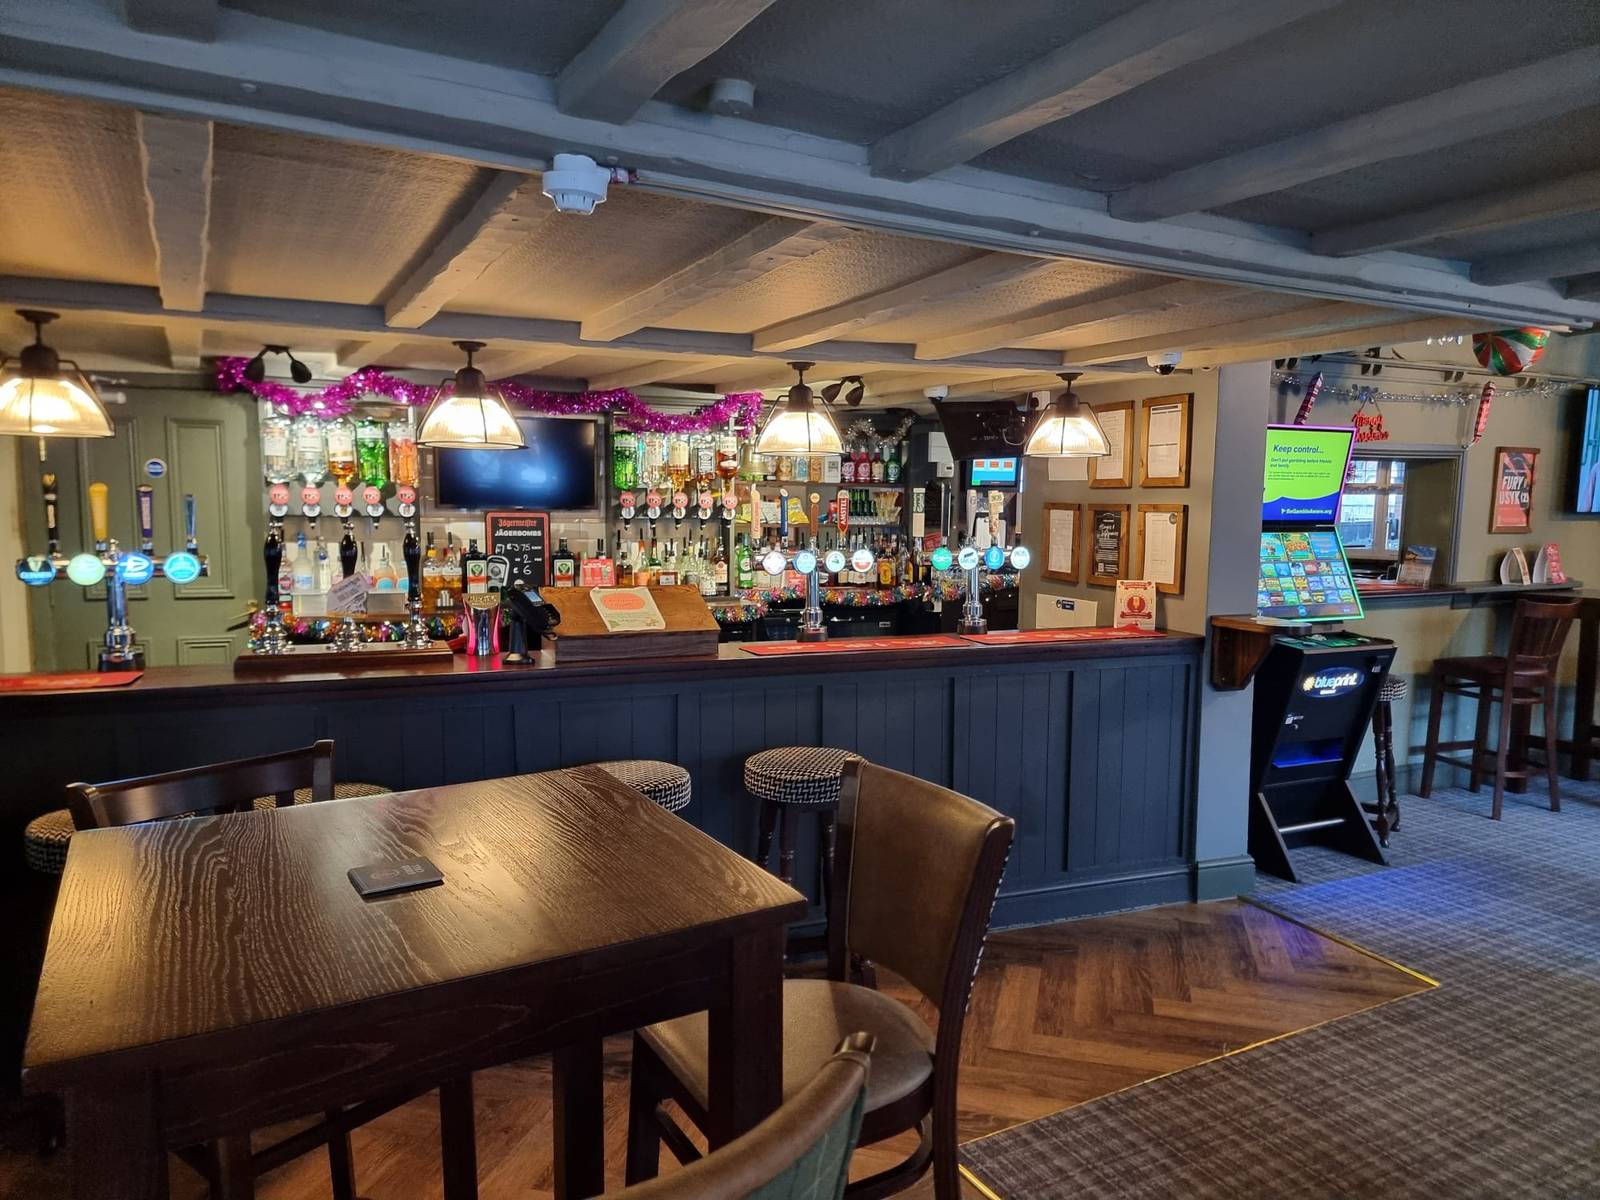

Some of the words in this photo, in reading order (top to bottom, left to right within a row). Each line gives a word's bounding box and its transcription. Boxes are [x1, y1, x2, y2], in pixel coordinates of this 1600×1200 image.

[1273, 444, 1292, 454] Keep
[1502, 475, 1525, 491] FURY
[1499, 490, 1521, 505] USYK
[494, 529, 542, 537] JÄGERBOMBS
[1314, 673, 1358, 689] blueprint
